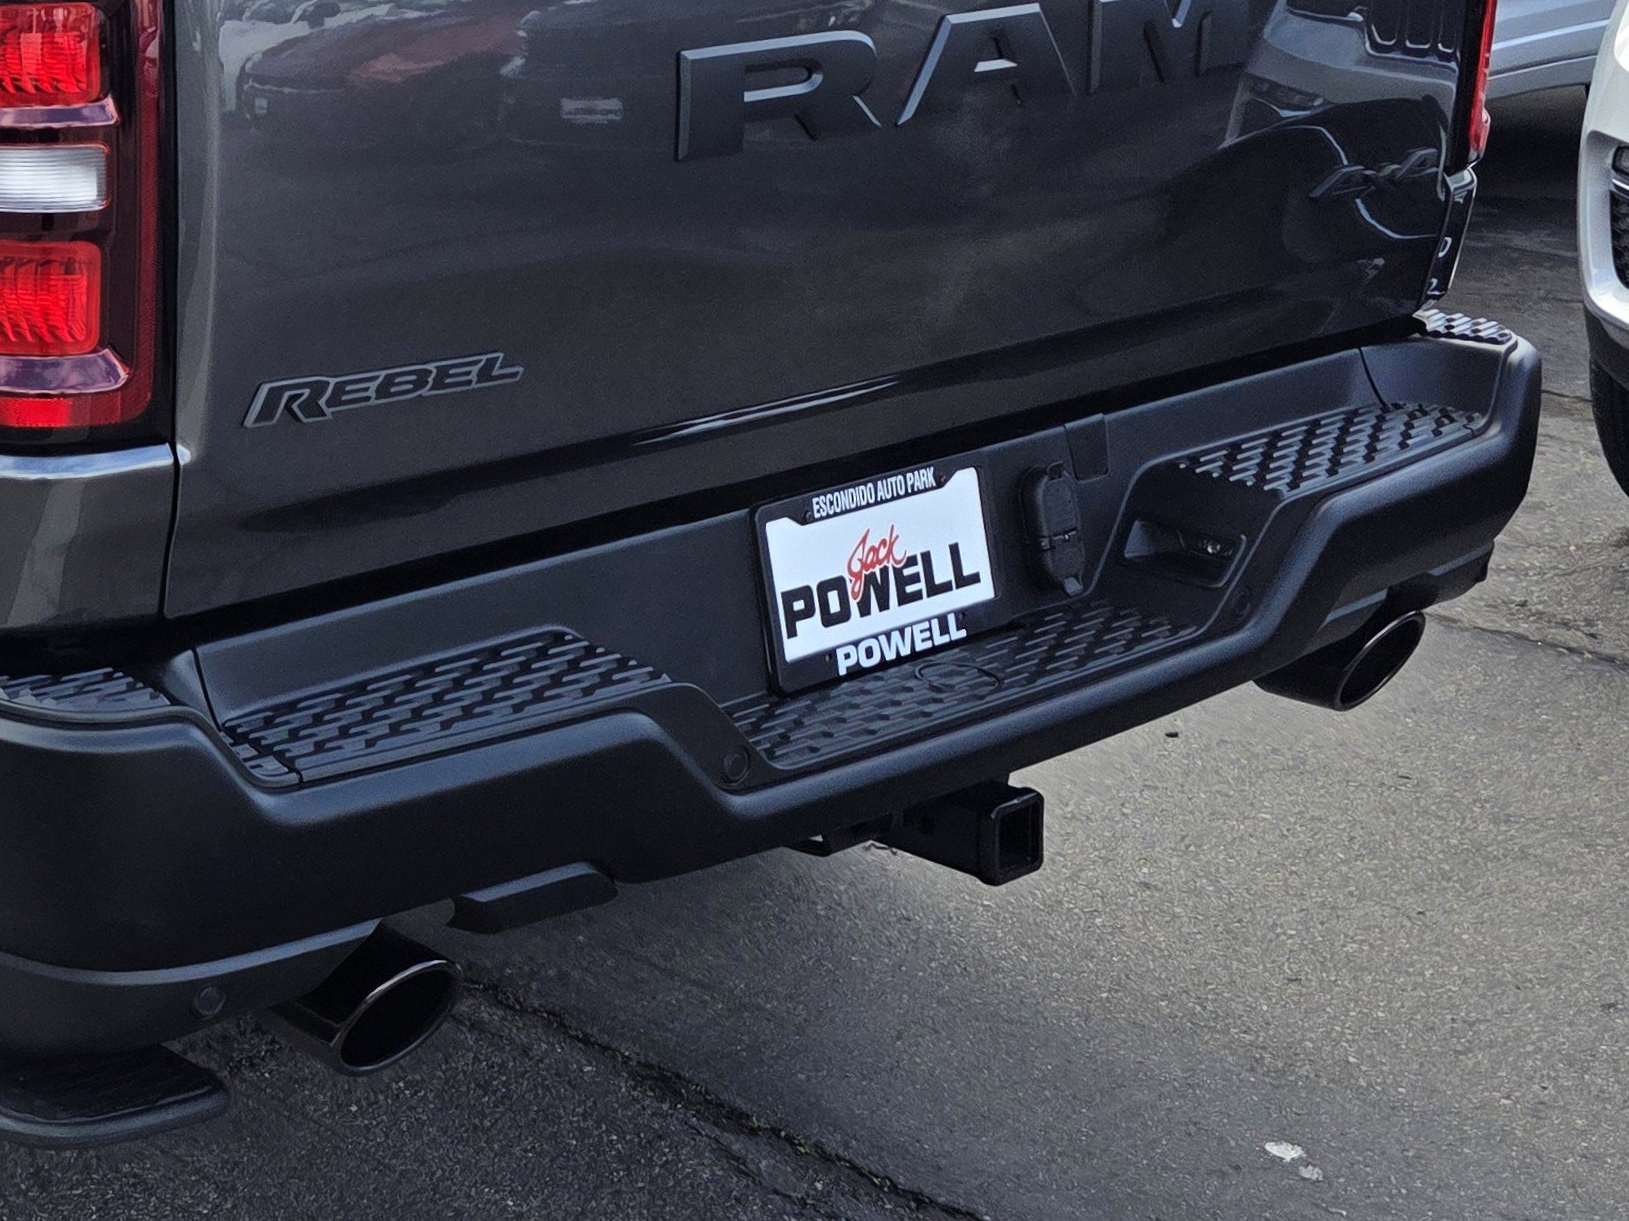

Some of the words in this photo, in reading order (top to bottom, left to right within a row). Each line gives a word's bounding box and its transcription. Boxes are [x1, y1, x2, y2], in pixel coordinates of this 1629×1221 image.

[242, 351, 525, 429] REBEL
[812, 482, 875, 519] ESCONDIDO
[877, 474, 906, 501] AUTO
[906, 466, 937, 493] PARK
[780, 541, 981, 640] POWELL
[846, 523, 908, 601] Jack
[836, 612, 967, 676] POWELL
